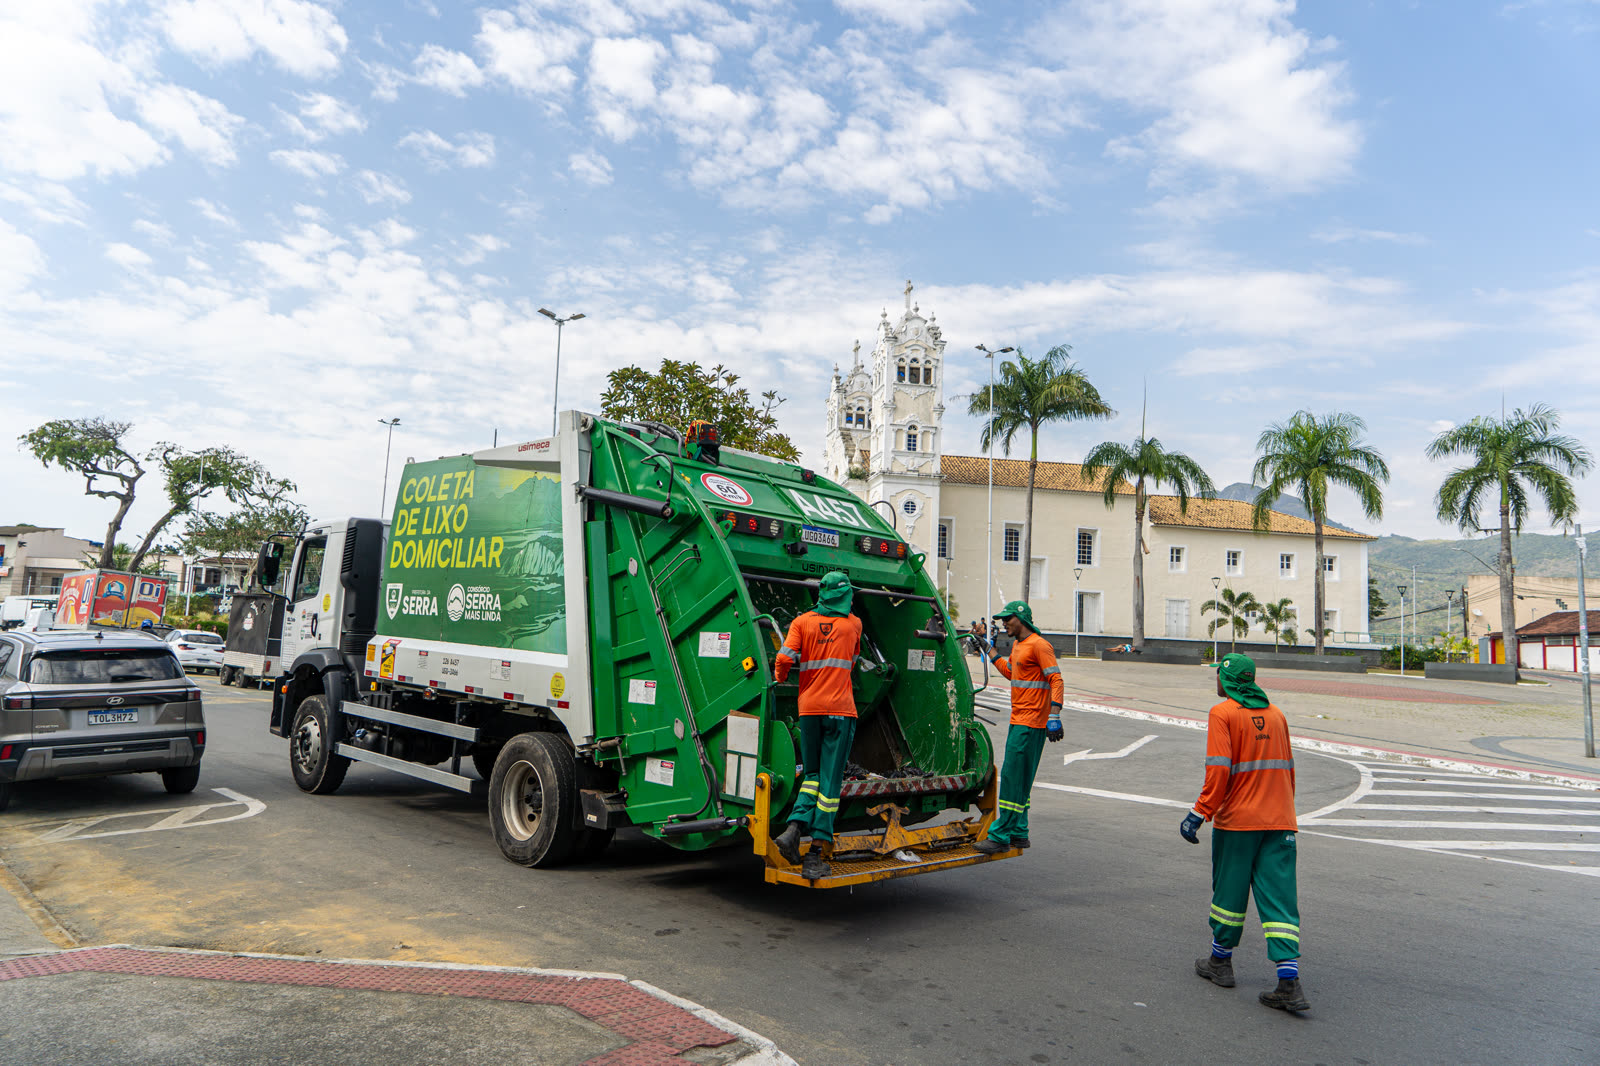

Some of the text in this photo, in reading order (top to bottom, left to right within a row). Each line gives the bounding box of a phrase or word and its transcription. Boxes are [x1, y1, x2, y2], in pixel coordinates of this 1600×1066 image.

[518, 440, 550, 452] usimeca
[402, 470, 475, 505] COLETA
[716, 484, 738, 495] 60
[788, 488, 873, 530] A457
[395, 503, 468, 536] DE LIXO
[390, 536, 504, 569] DOMICILIAR
[139, 581, 161, 599] Oi
[467, 585, 490, 593] CONSÓRCIO
[402, 595, 438, 616] SERRA
[465, 593, 501, 611] SERRA
[464, 610, 501, 622] MAIS LINDA
[93, 713, 134, 723] TOL3H72
